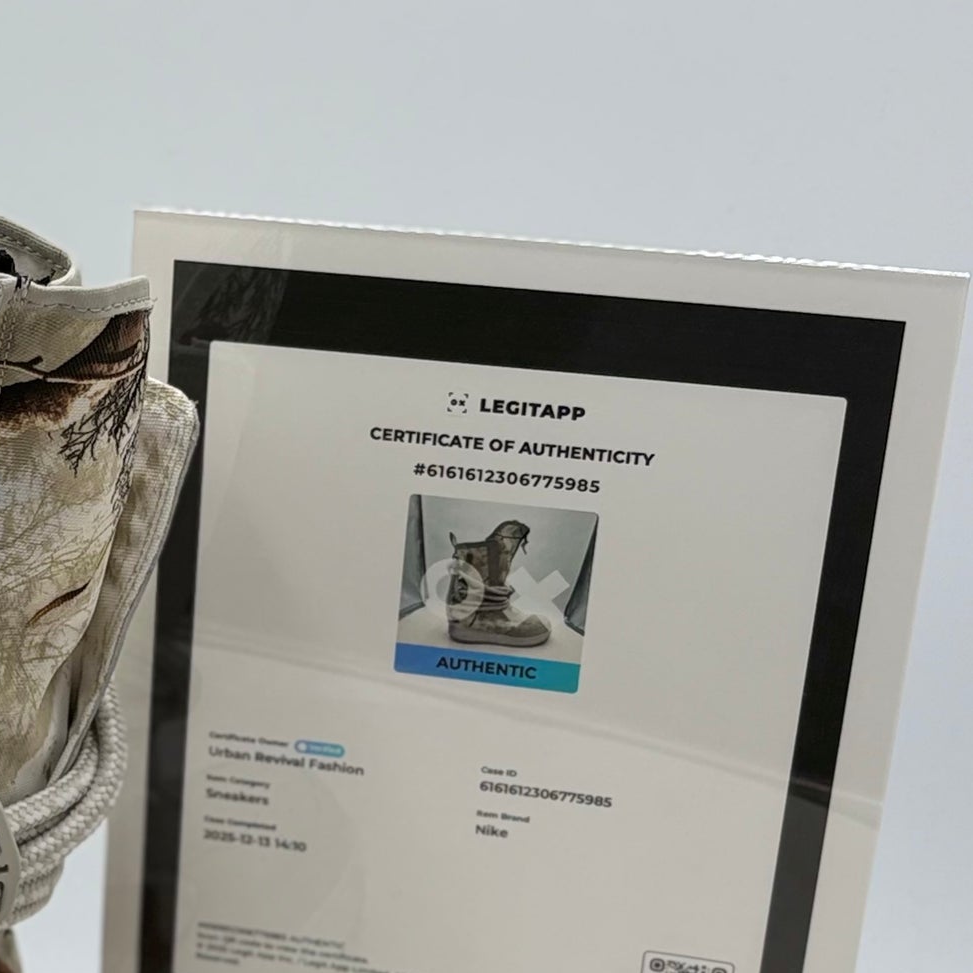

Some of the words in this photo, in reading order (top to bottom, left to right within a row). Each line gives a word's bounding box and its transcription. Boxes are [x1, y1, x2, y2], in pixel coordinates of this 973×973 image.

[479, 398, 586, 421] LEGITAPP
[370, 427, 484, 450] CERTIFICATE
[489, 438, 515, 453] OF
[518, 442, 655, 466] AUTHENTICITY
[413, 463, 601, 493] #6161612306775985
[435, 656, 537, 679] AUTHENTIC
[209, 746, 251, 761] Urban
[255, 752, 305, 768] Revival
[309, 758, 365, 776] Fashion
[481, 766, 504, 776] Case
[206, 788, 269, 805] Sneakers
[479, 781, 613, 808] 6161612306775985
[475, 825, 509, 838] Nike
